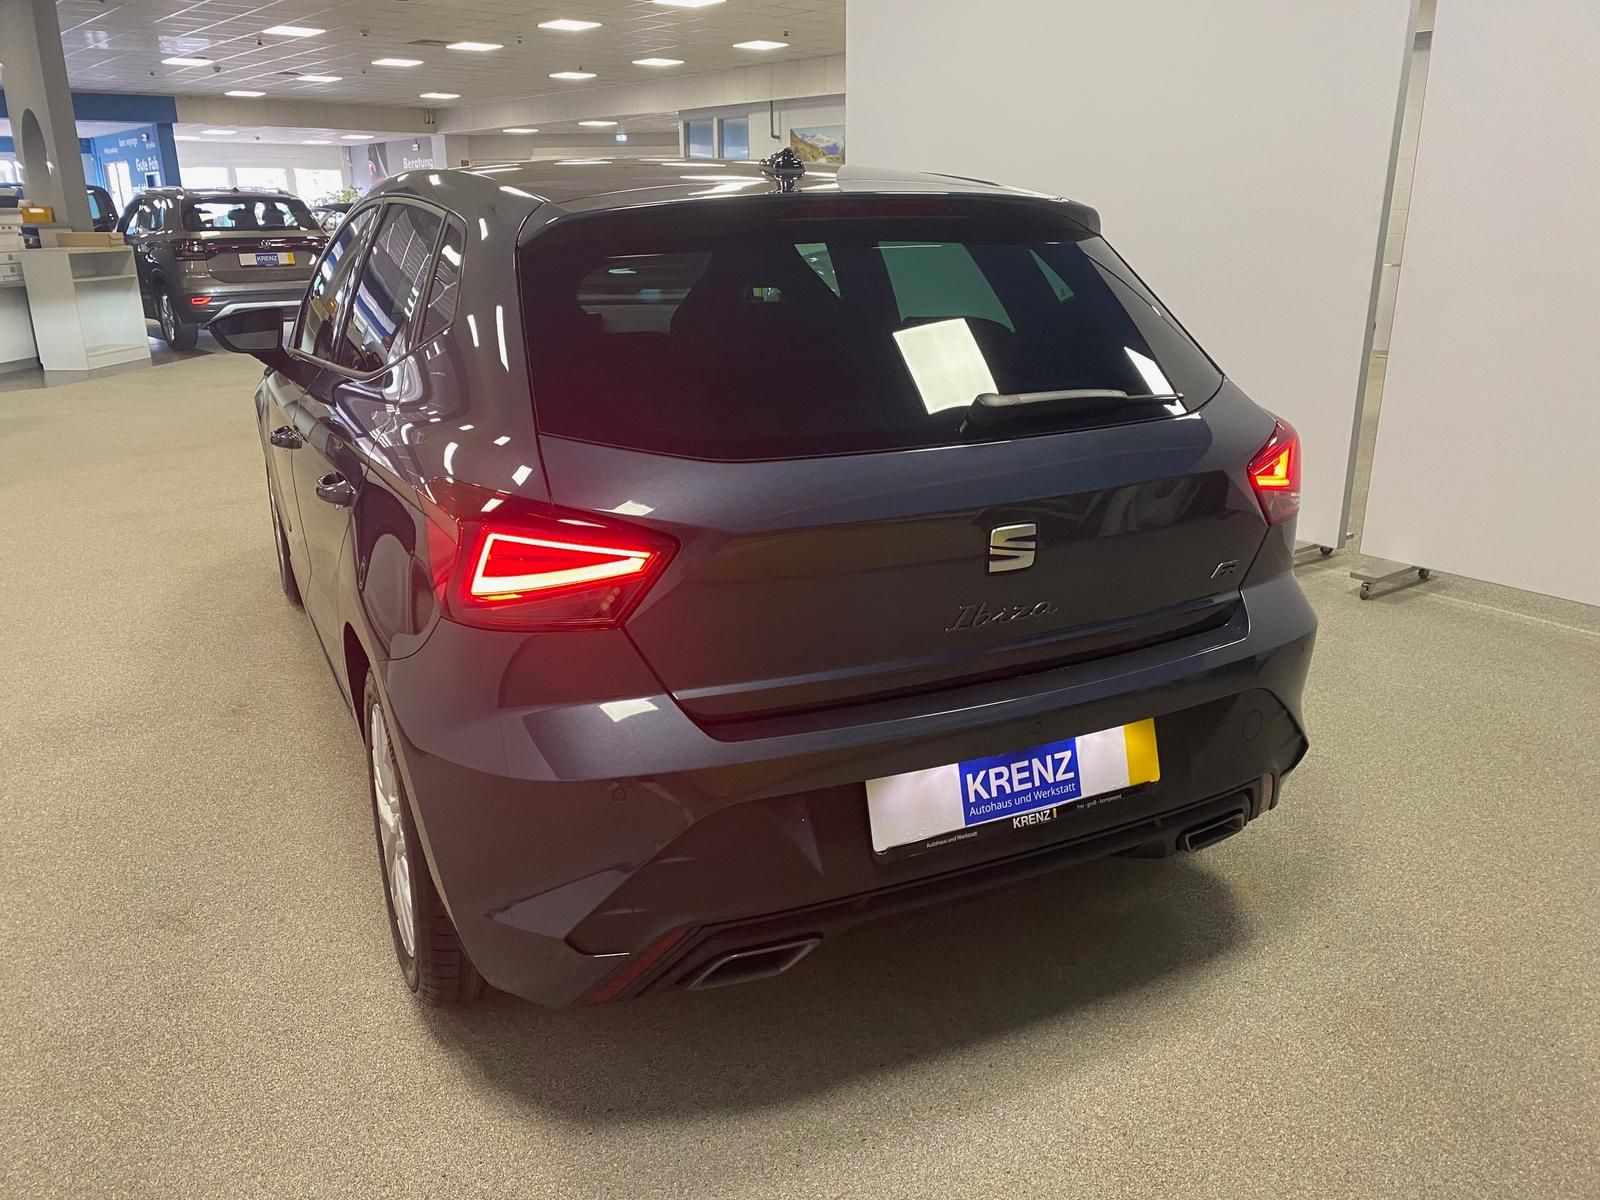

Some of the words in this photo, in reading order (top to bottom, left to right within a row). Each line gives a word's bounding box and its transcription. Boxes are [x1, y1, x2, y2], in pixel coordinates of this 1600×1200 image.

[403, 157, 433, 169] Beratung
[944, 600, 1059, 632] Ibiza
[966, 749, 1075, 803] KRENZ
[969, 797, 1012, 816] Autohaus
[1015, 792, 1032, 807] und
[1034, 782, 1076, 802] Werkstatt
[1012, 809, 1051, 829] KRENZ
[926, 838, 947, 848] Autohaus
[957, 831, 978, 841] Werkstatt
